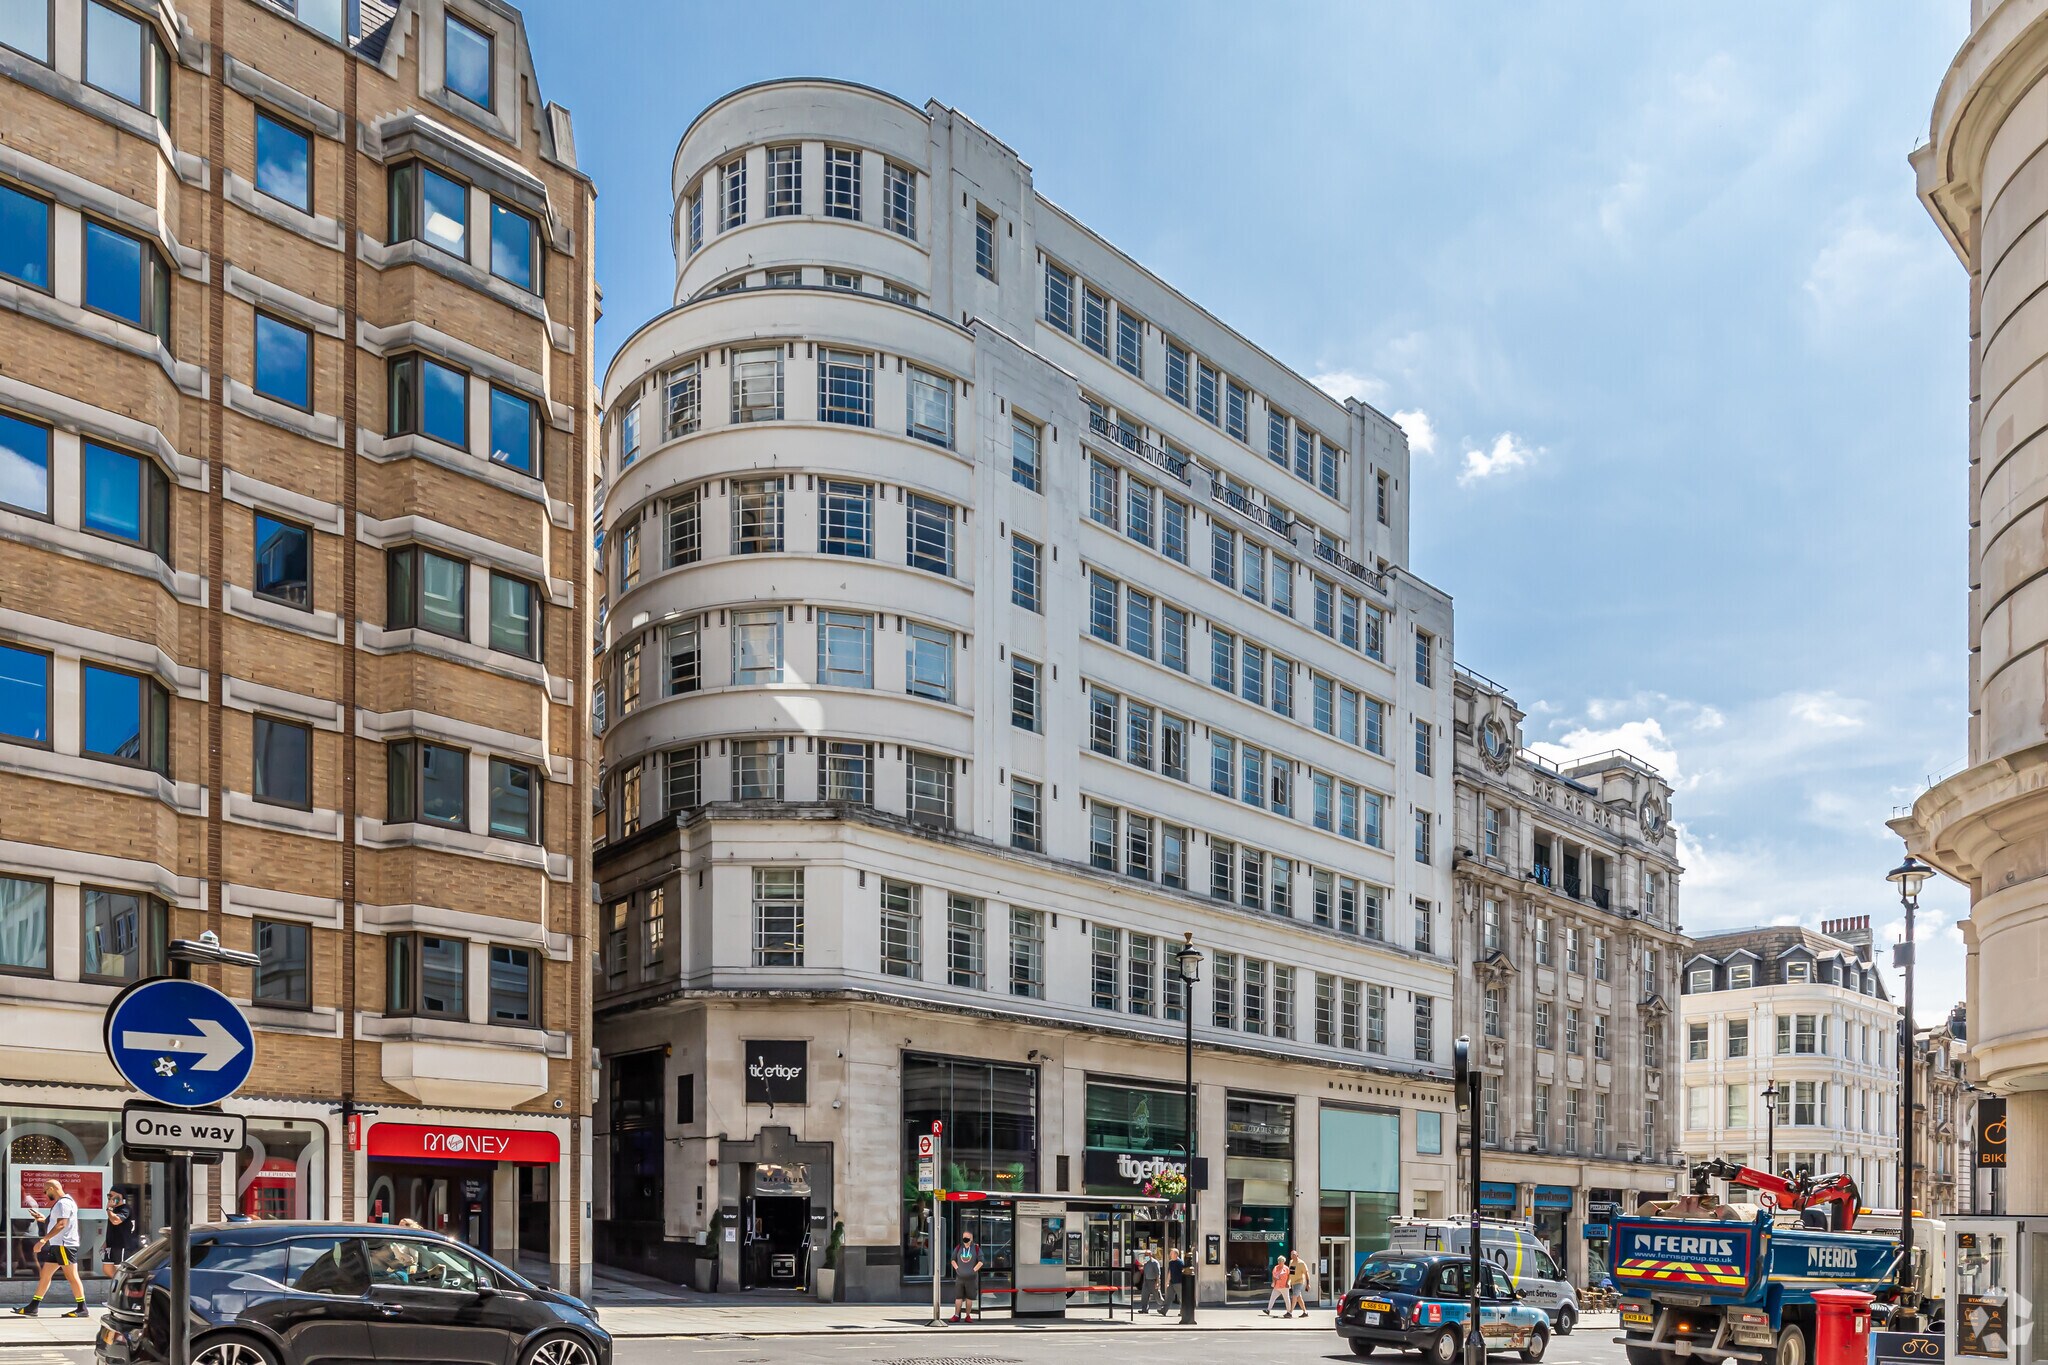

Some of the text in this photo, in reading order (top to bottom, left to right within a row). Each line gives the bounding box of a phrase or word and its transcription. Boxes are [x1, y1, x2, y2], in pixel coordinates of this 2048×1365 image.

[1328, 1082, 1447, 1104] HAYMARKET HOUSE
[136, 1118, 235, 1143] One way
[933, 1123, 940, 1132] R
[424, 1133, 510, 1153] MONEY
[1654, 1235, 1733, 1256] FERNS
[1634, 1251, 1733, 1263] www.fernsgroup.co.uk
[1818, 1247, 1857, 1268] FERNS
